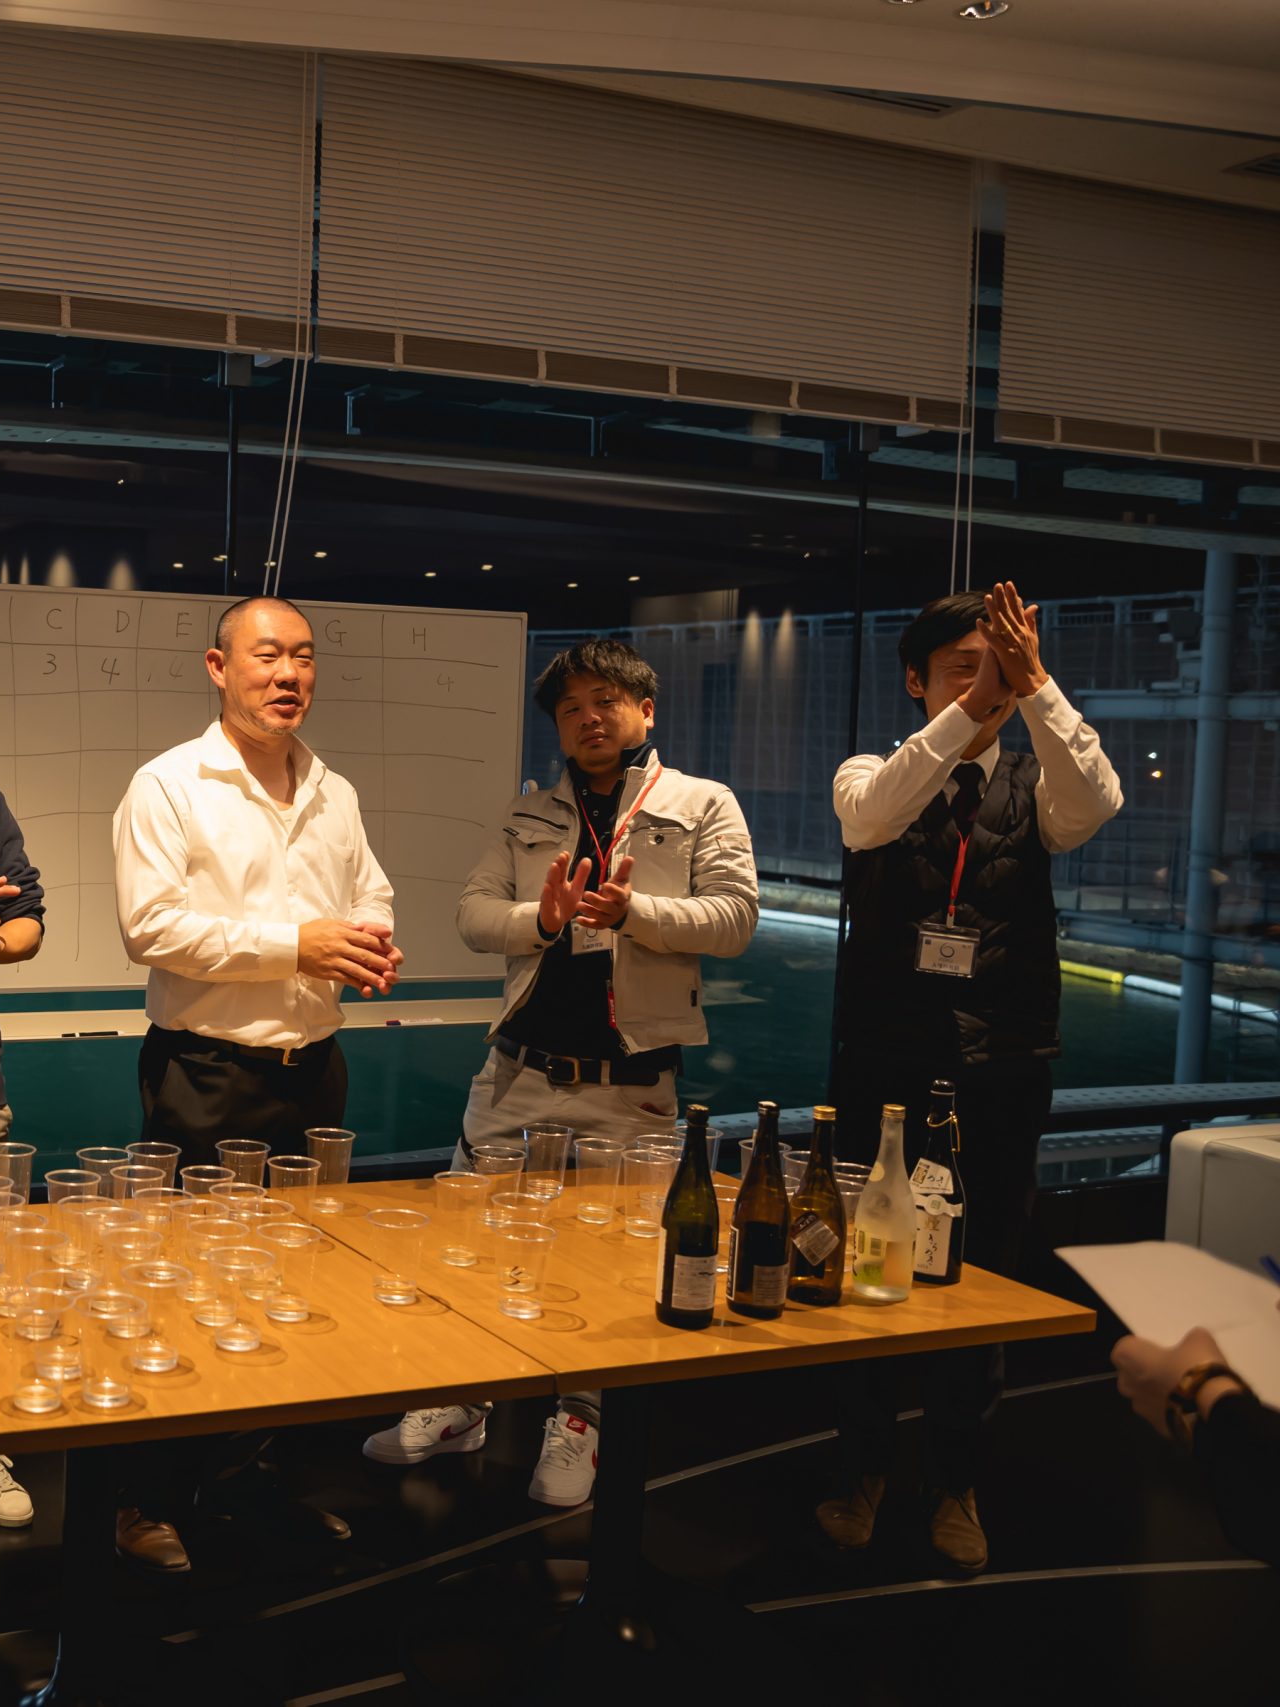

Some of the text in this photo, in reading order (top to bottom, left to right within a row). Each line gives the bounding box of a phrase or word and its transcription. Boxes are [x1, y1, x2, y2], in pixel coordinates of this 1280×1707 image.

[46, 608, 63, 630] C
[116, 610, 130, 633] D
[175, 612, 193, 638] E
[325, 619, 348, 647] G
[412, 627, 426, 652] H
[42, 653, 58, 675] 3
[100, 658, 120, 685] 4
